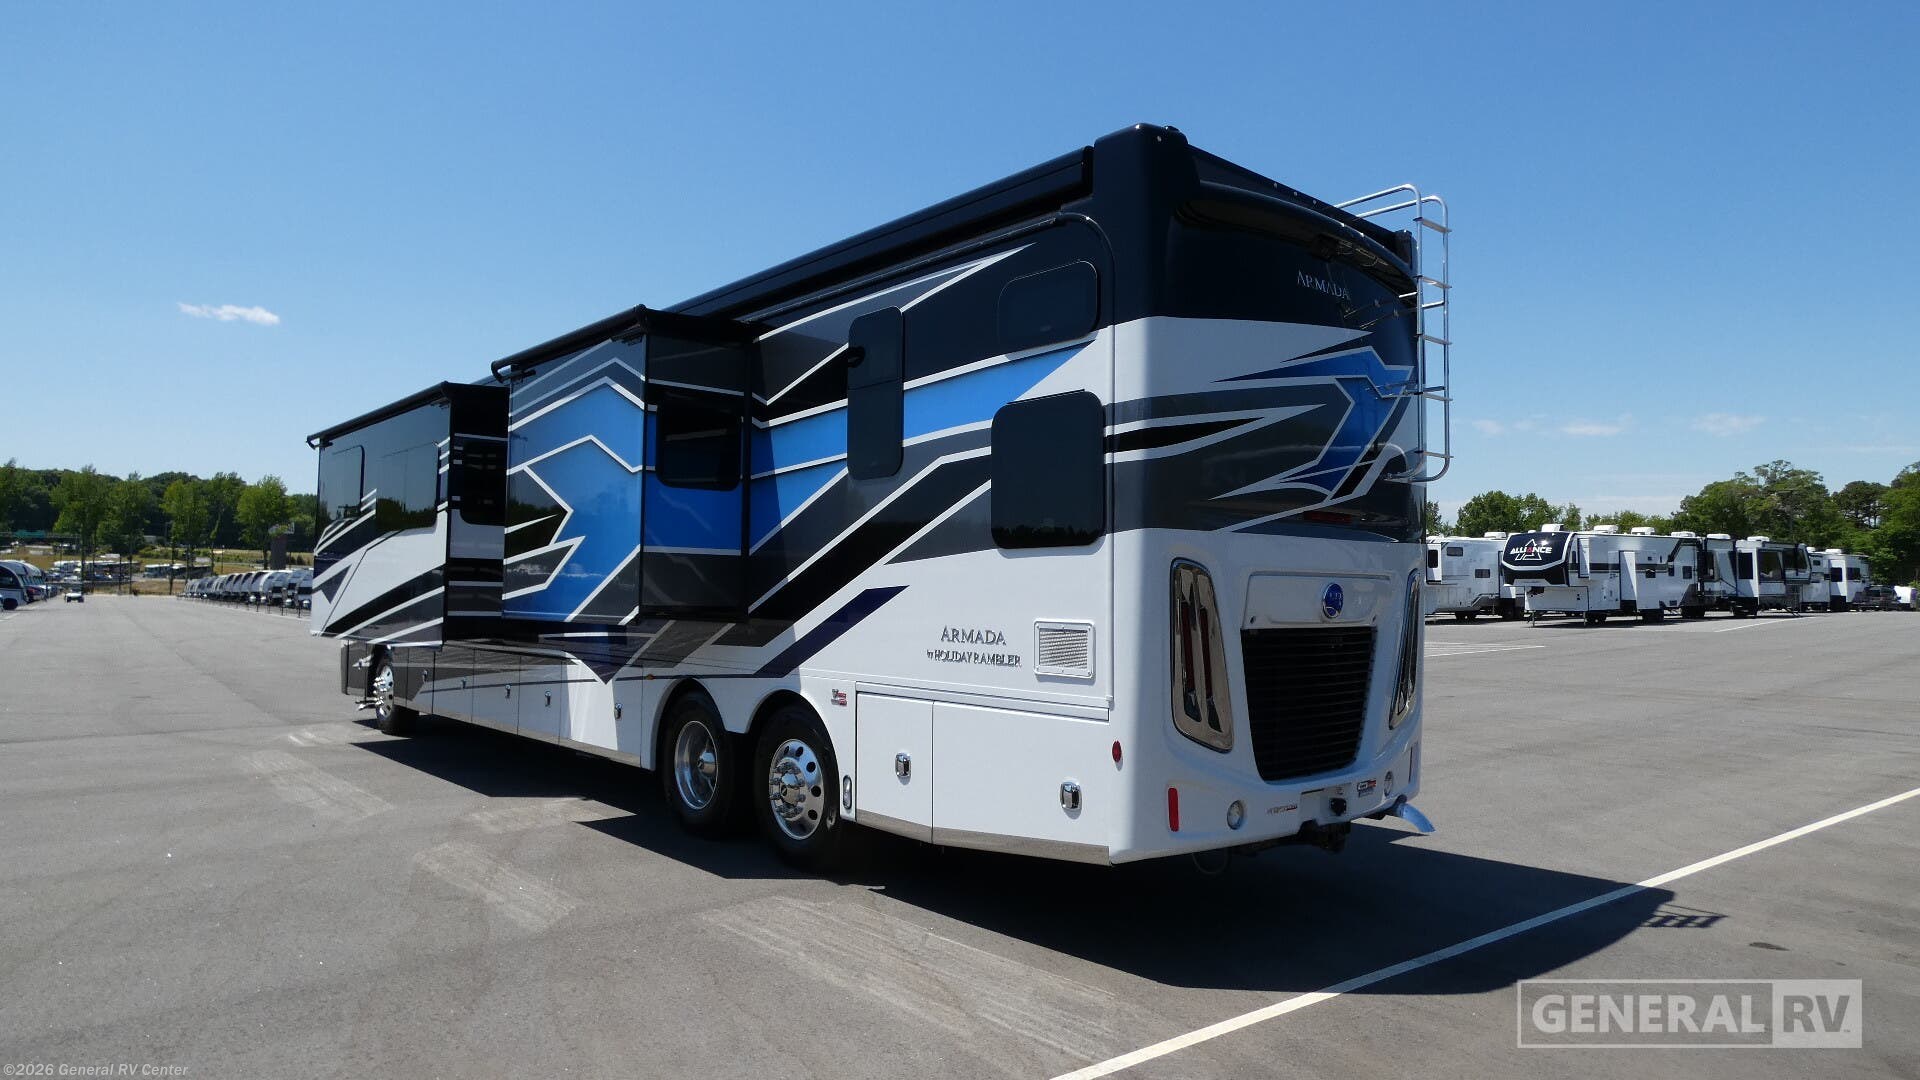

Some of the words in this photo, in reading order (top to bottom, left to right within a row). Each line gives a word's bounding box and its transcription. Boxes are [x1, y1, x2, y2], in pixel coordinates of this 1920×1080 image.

[1297, 270, 1351, 300] ARMADA
[1510, 546, 1552, 555] ALLIANCE
[940, 625, 1006, 646] ARMADA
[935, 649, 973, 664] HOLIDAY
[973, 652, 1021, 668] RAMBLER
